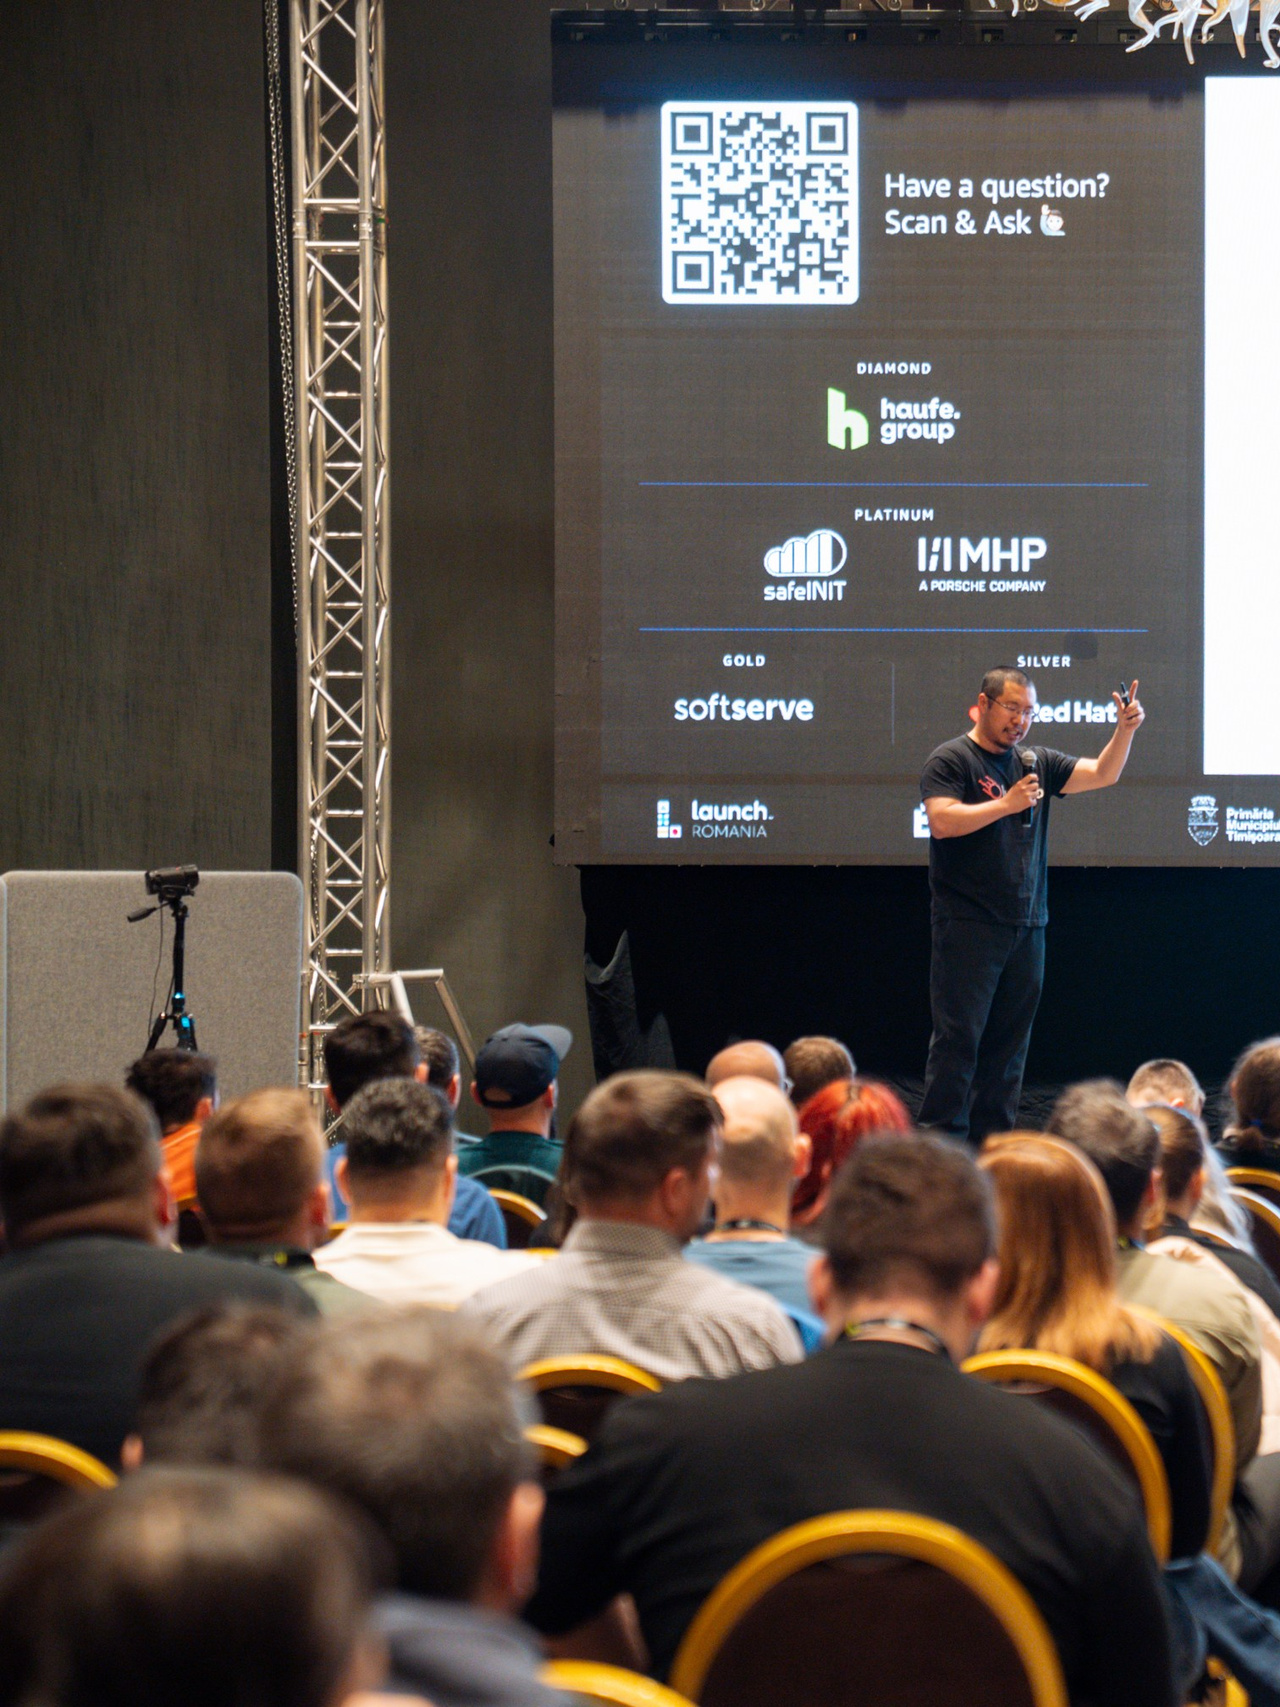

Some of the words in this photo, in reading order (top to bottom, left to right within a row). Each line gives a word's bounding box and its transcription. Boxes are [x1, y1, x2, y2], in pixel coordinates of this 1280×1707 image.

[885, 173, 951, 198] Have
[958, 179, 973, 198] a
[981, 173, 1110, 205] question?
[885, 209, 948, 235] Scan
[954, 209, 977, 235] &
[983, 208, 1032, 235] Ask
[856, 362, 932, 375] DIAMOND
[880, 396, 961, 420] haufe.
[880, 422, 955, 445] group
[854, 508, 935, 521] PLATINUM
[959, 536, 1048, 573] MHP
[763, 580, 847, 601] safeINIT
[918, 580, 929, 592] A
[930, 581, 986, 592] PORSCHE
[989, 581, 1047, 592] COMPANY
[722, 653, 766, 667] GOLD
[1017, 655, 1071, 668] SILVER
[673, 692, 815, 721] softserve
[692, 824, 768, 838] ROMANIA
